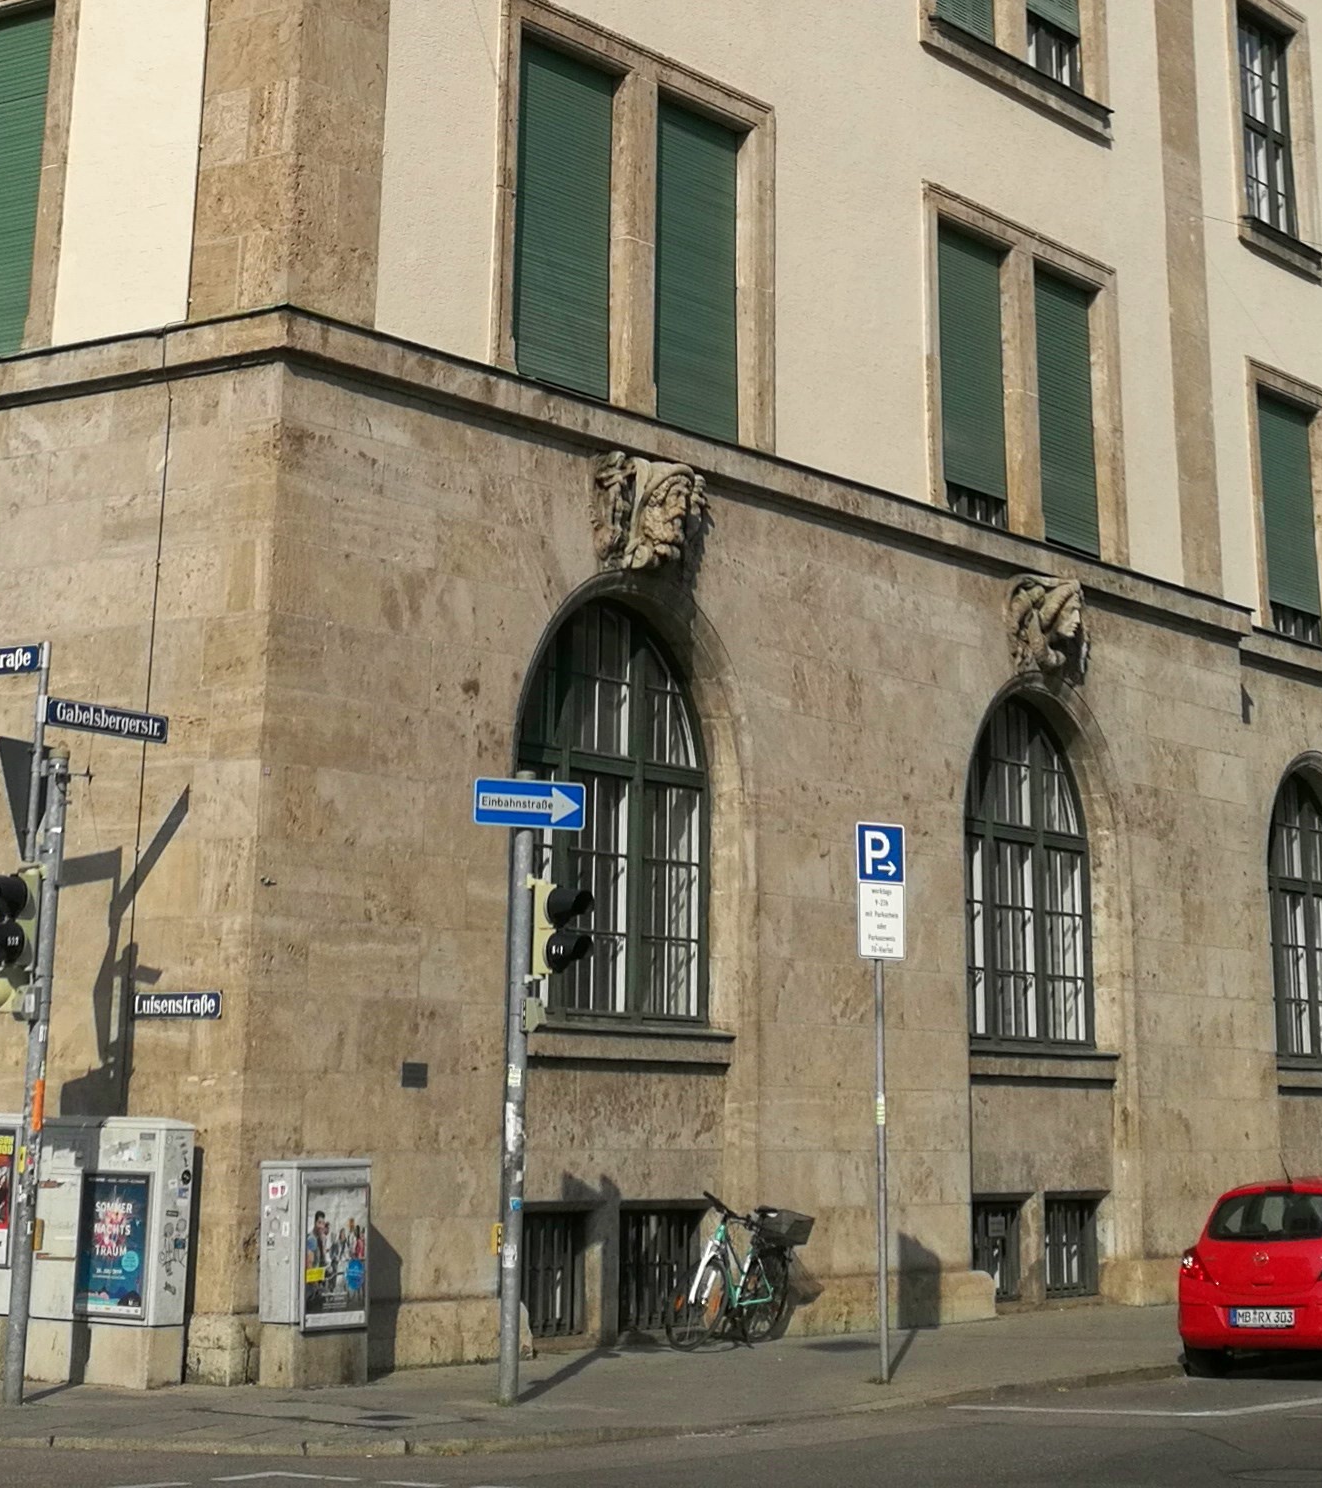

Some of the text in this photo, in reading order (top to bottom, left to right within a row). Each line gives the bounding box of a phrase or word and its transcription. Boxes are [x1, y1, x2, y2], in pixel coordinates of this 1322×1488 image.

[56, 702, 161, 736] Gabelsbergerstr.
[481, 796, 554, 810] Einbahnstraße
[864, 830, 891, 875] P
[134, 994, 216, 1017] Luisenstraße
[95, 1201, 133, 1214] SOMMER
[94, 1223, 131, 1236] NACHTS
[94, 1244, 127, 1257] TRAUM
[1238, 1311, 1293, 1323] MB RX 303
